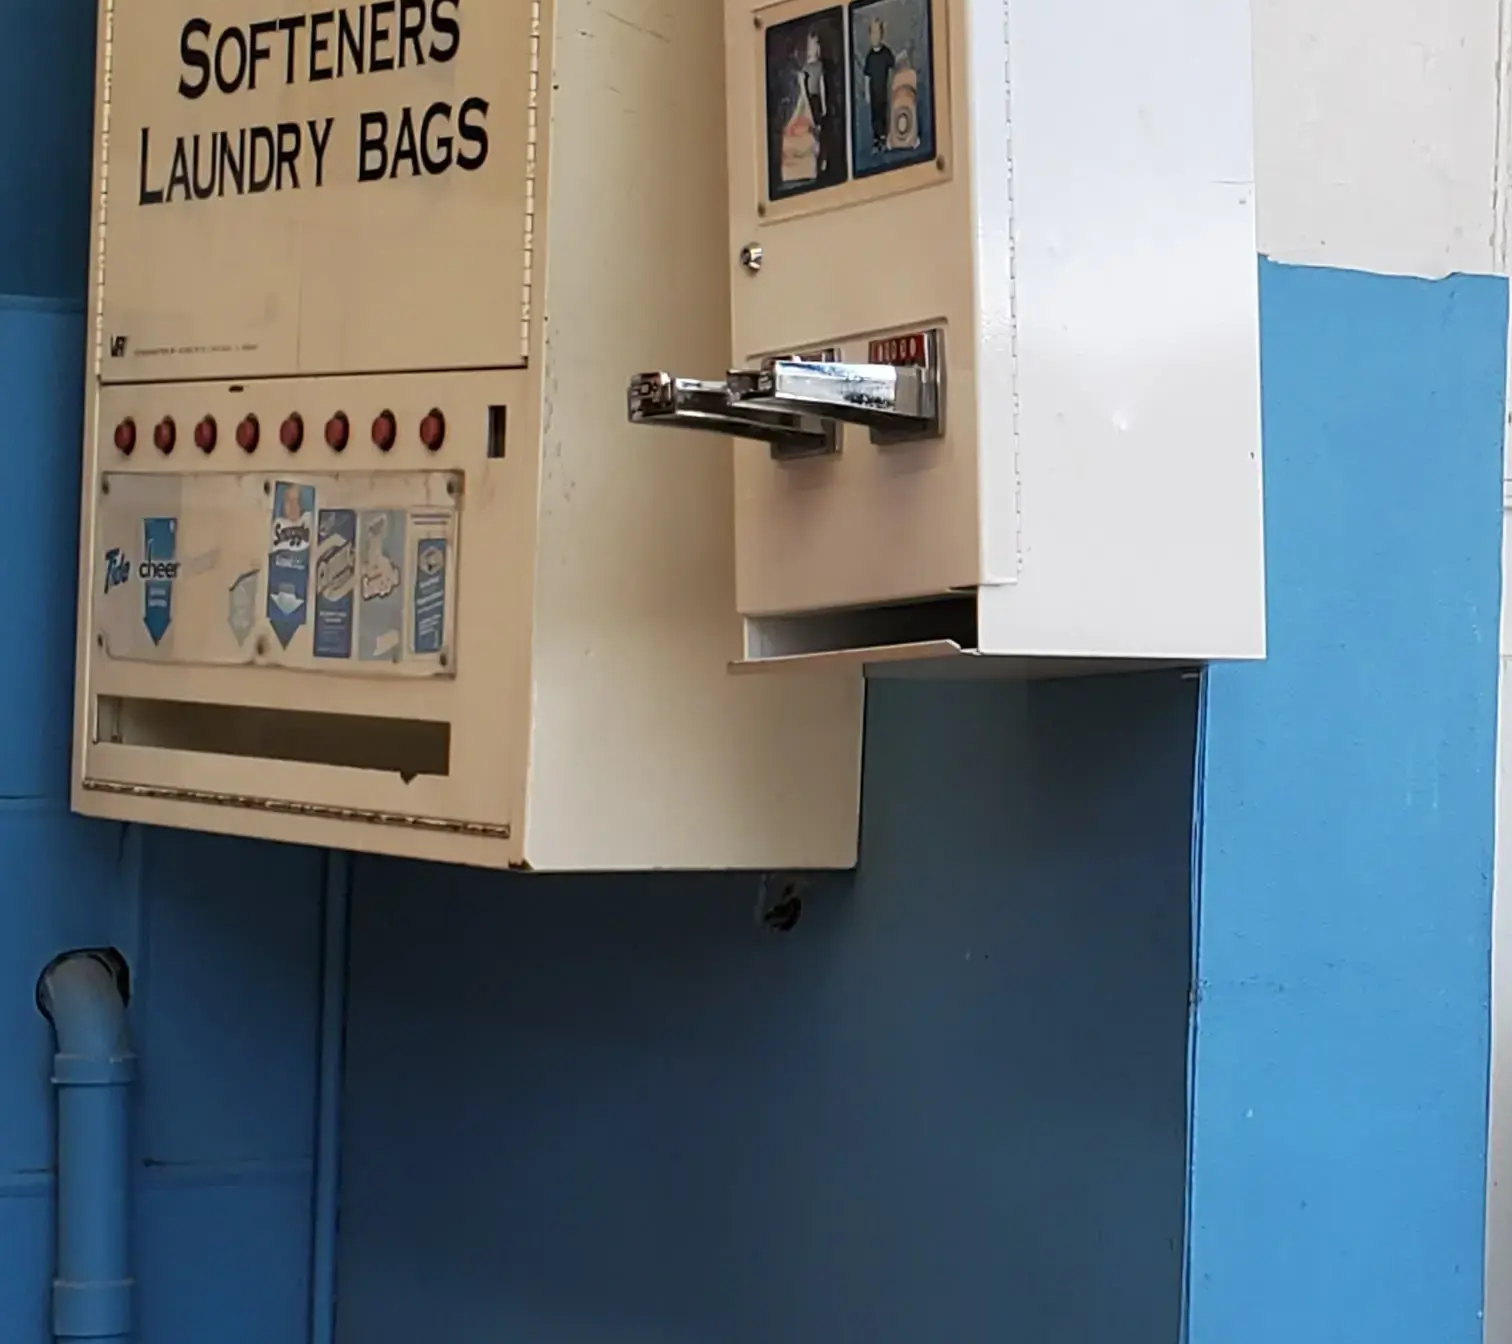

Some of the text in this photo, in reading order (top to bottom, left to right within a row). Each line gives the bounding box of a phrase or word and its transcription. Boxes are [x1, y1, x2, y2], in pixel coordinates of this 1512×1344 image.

[137, 97, 491, 206] LAUNDRY BAGS
[103, 547, 130, 594] Tide
[138, 545, 180, 579] cheer
